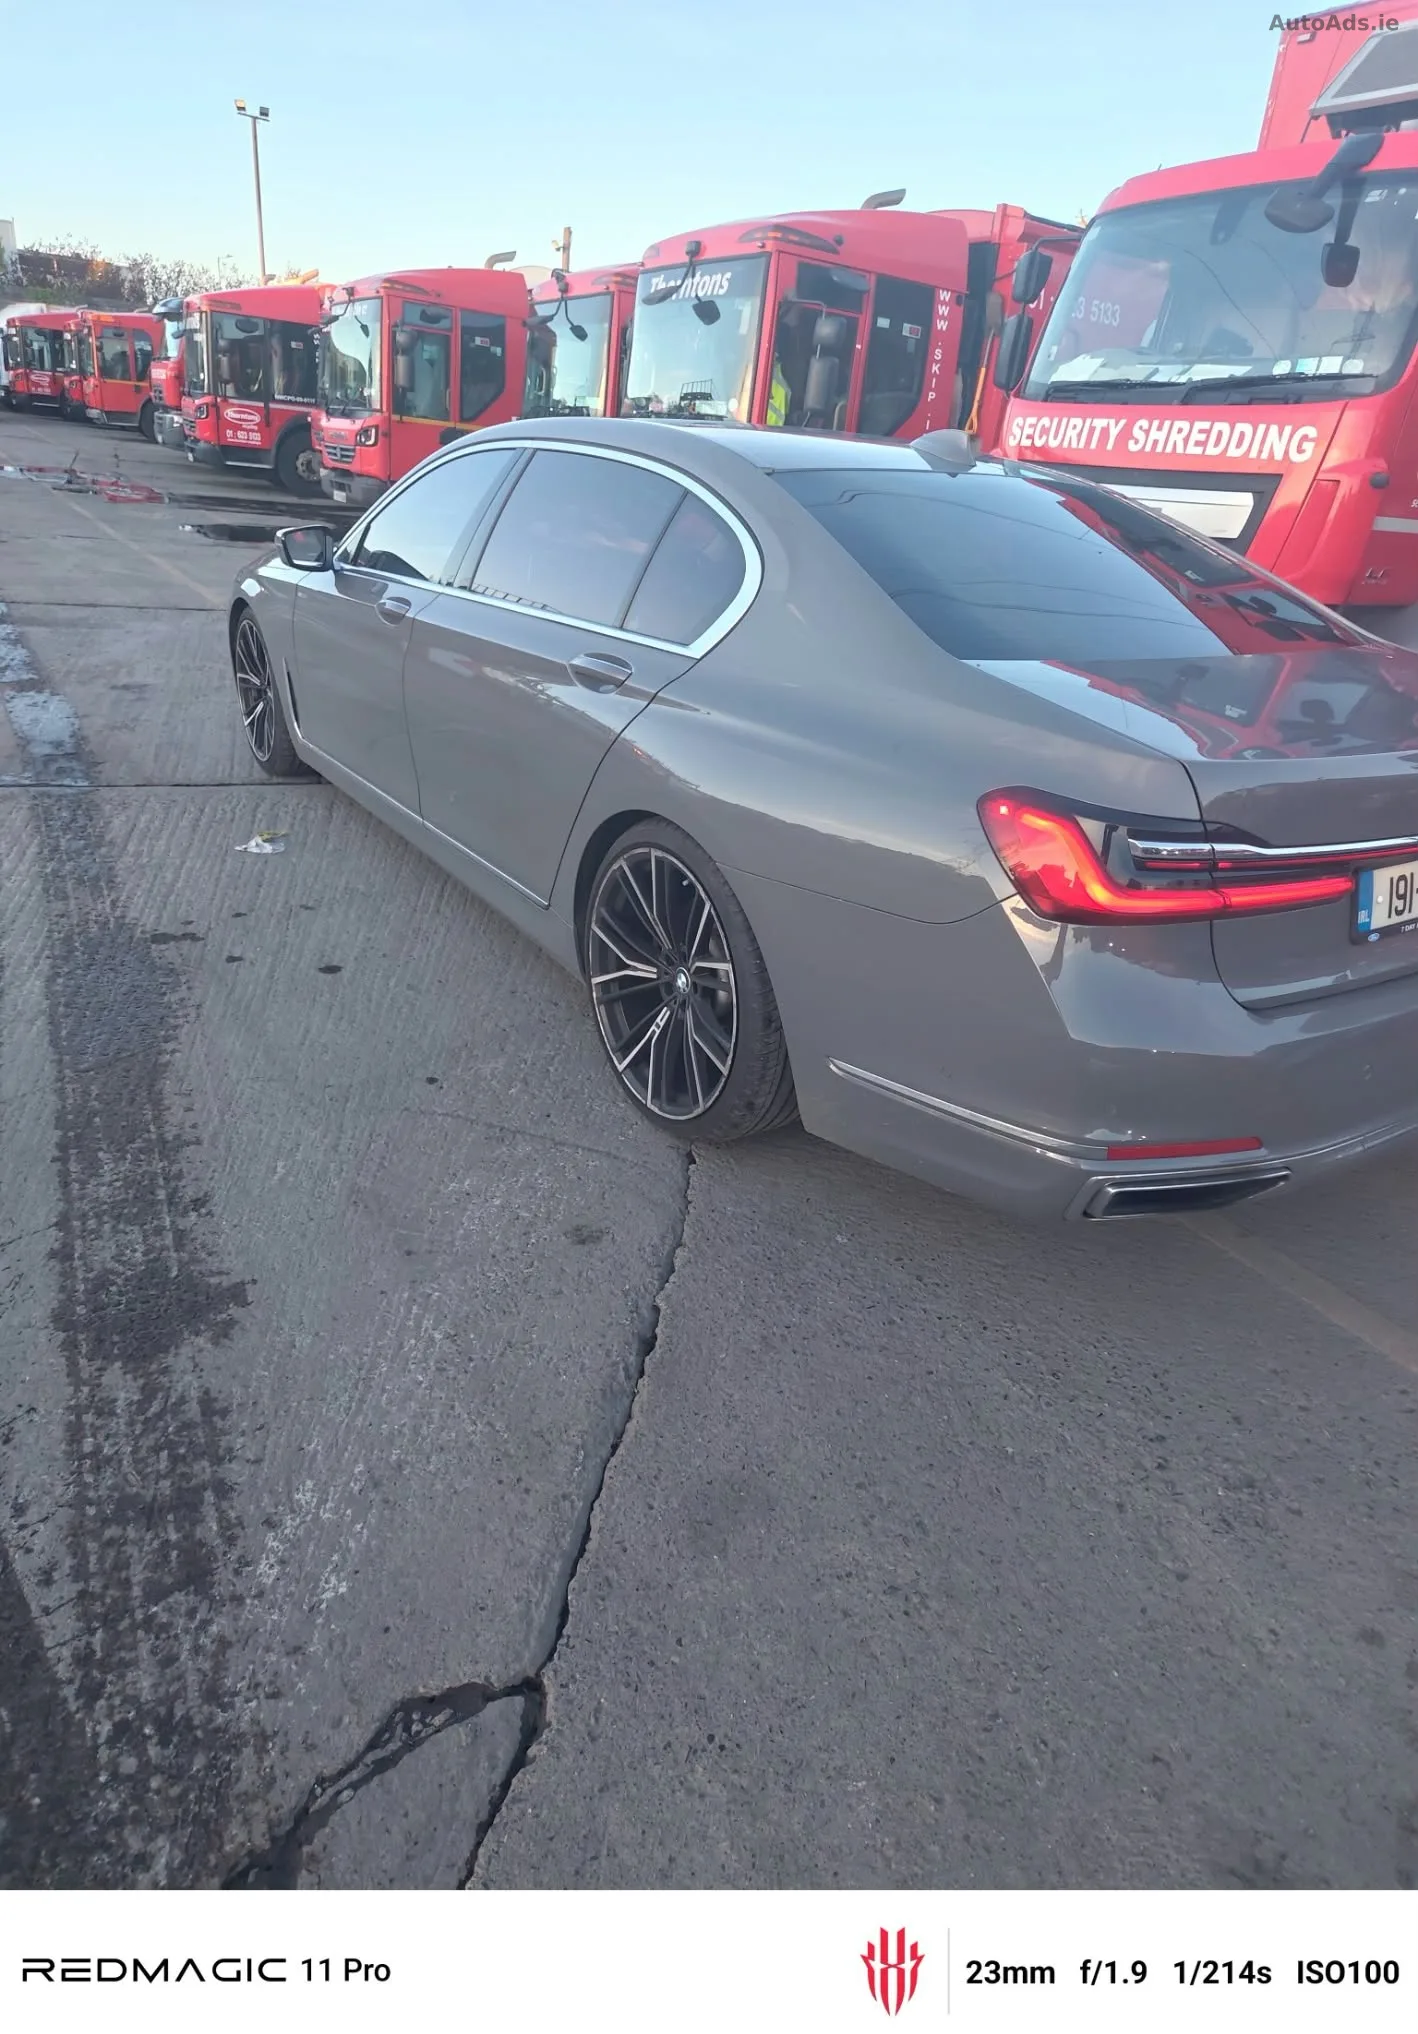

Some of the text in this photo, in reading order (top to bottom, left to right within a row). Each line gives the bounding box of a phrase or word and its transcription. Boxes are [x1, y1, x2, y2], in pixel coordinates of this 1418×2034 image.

[1090, 300, 1120, 328] 5133
[1008, 416, 1318, 463] SECURITY SHREDDING
